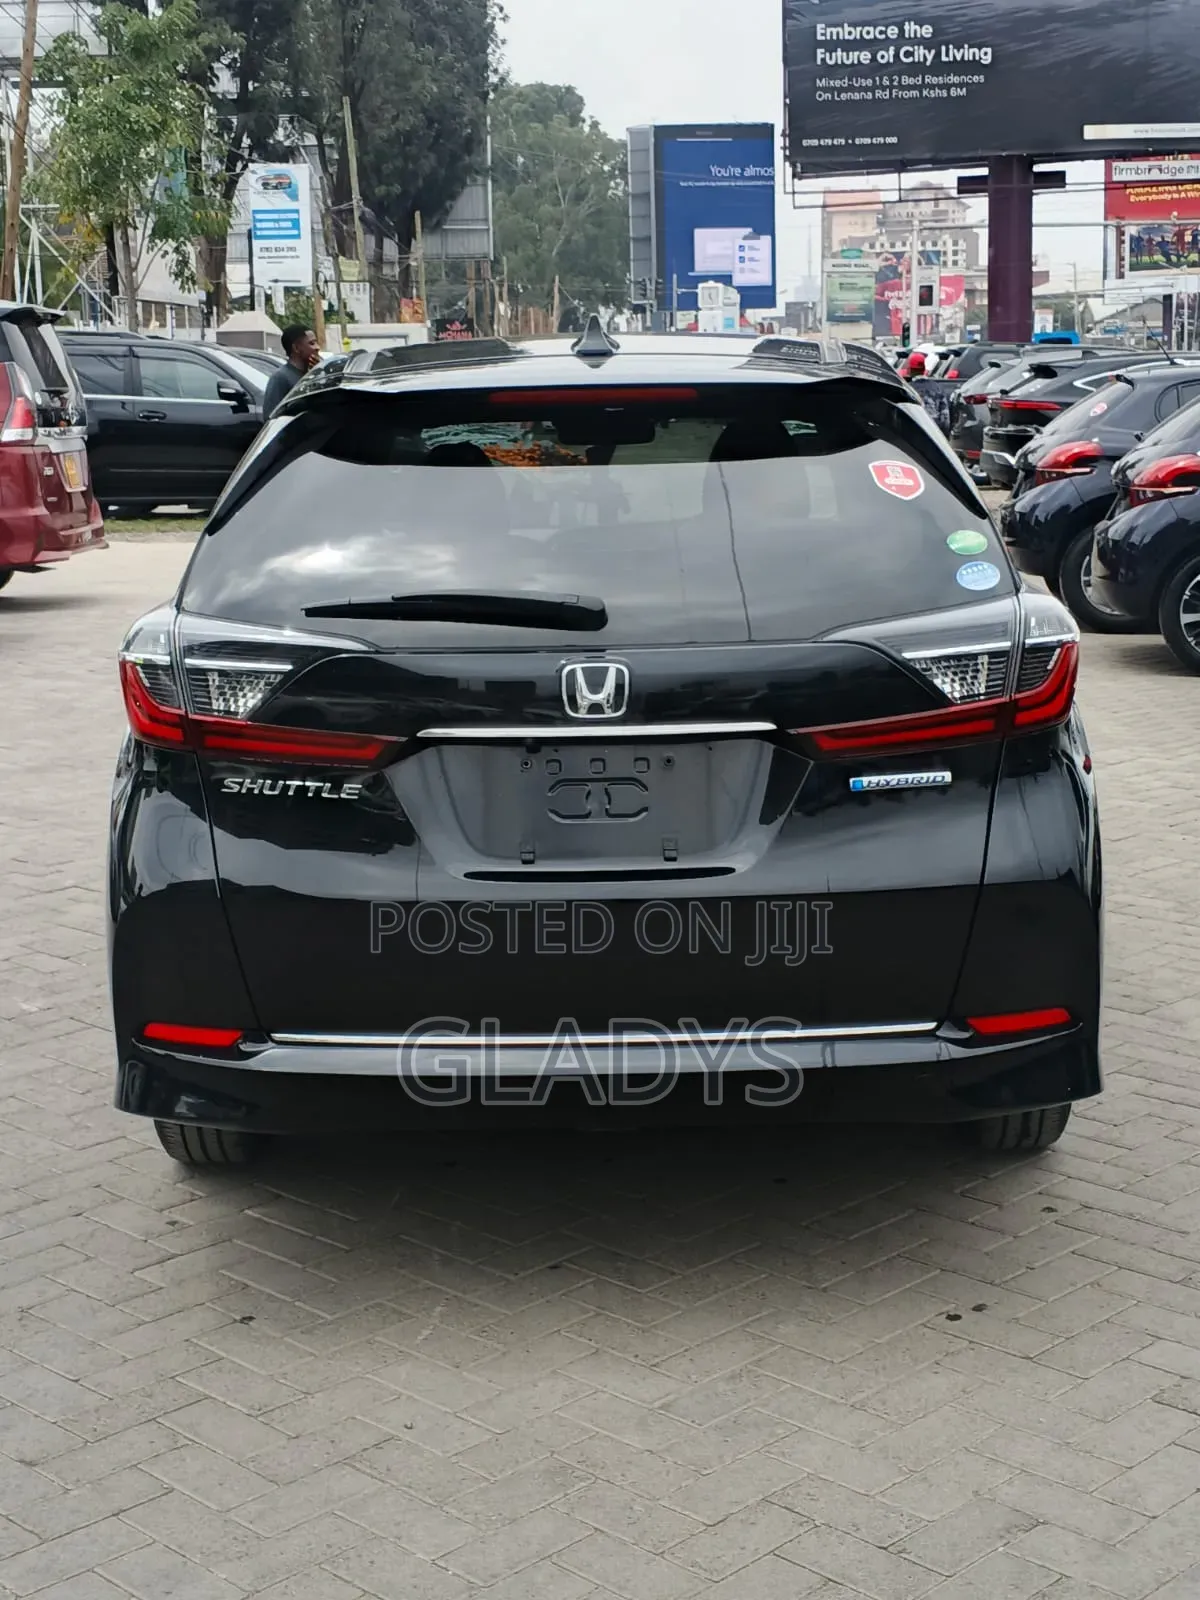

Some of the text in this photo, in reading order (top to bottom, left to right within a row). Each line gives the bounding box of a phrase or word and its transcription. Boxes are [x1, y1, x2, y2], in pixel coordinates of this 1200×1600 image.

[816, 21, 934, 41] Embrace the
[816, 44, 993, 66] Future of City Living
[816, 73, 985, 88] Mixed-Use 1 & 2 Bed Residences
[816, 91, 832, 101] On
[834, 90, 872, 101] Lenana
[875, 89, 889, 99] Rd
[892, 89, 920, 99] From
[922, 87, 948, 98] Kshs
[709, 164, 742, 177] You're
[221, 777, 363, 799] SHUTTLE
[866, 775, 946, 789] HYBRID
